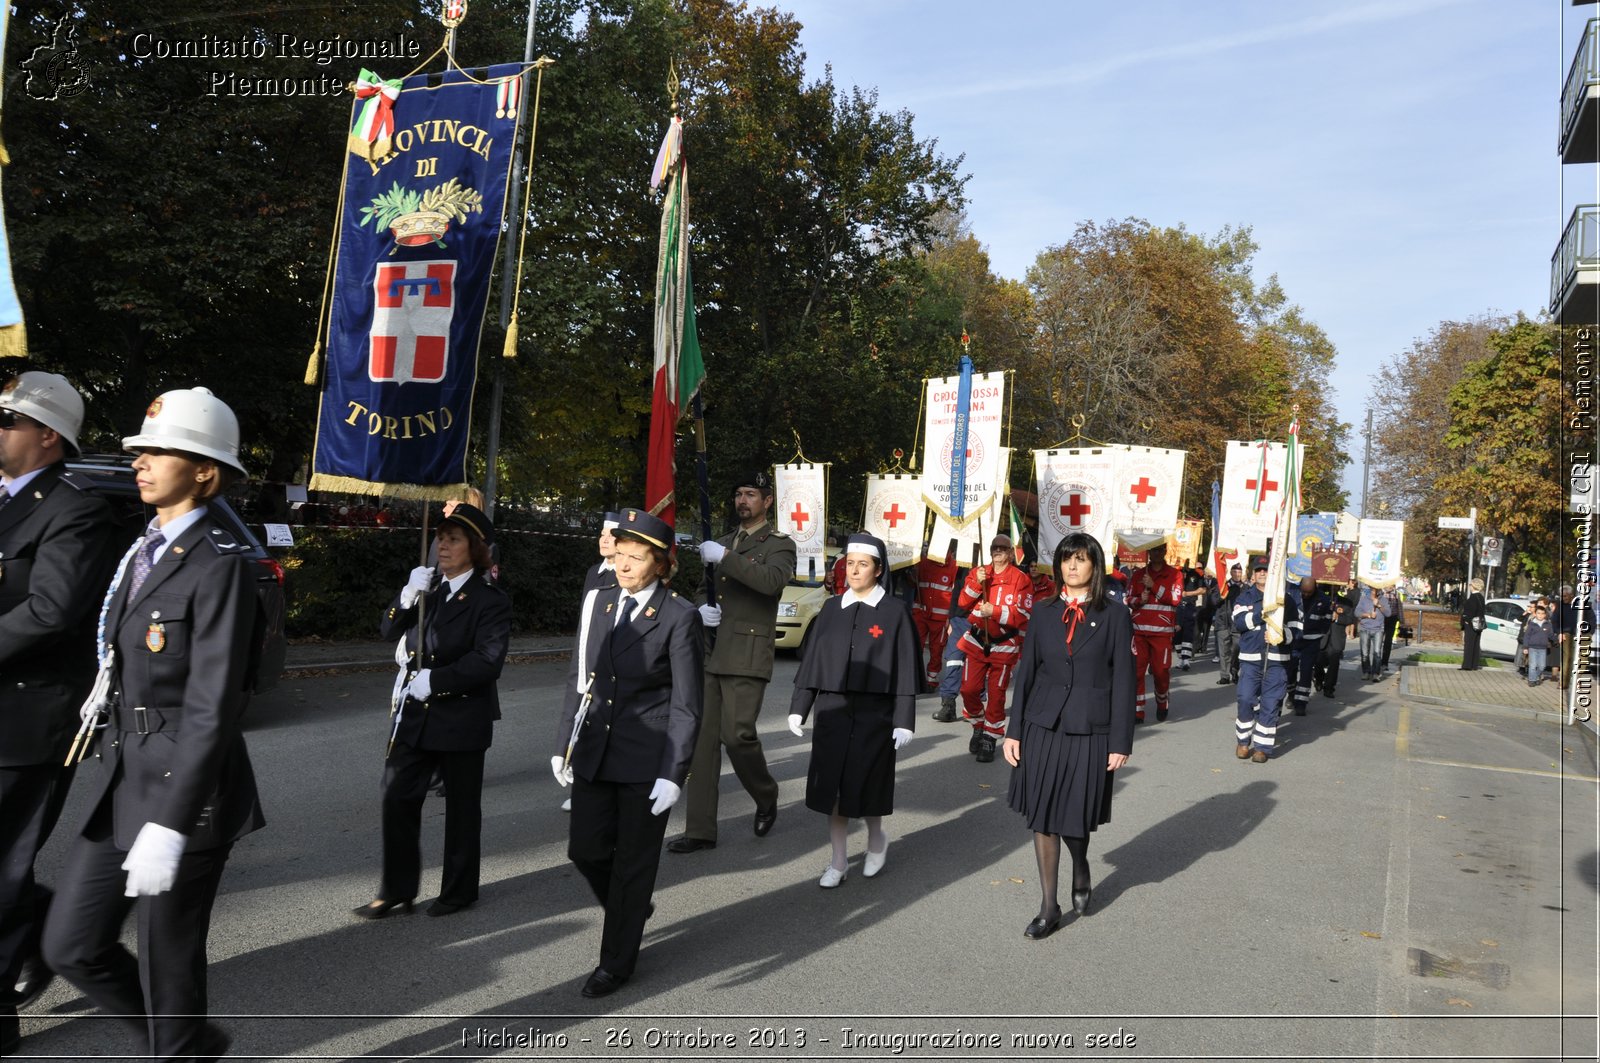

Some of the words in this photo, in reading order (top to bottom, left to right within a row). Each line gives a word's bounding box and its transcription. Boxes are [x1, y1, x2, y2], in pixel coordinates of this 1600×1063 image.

[414, 157, 439, 178] DI
[933, 390, 958, 403] CROC
[972, 386, 999, 399] OSSA
[943, 401, 985, 414] ITANA
[344, 400, 453, 440] TORINO
[955, 413, 965, 450] SOCCORSO
[933, 484, 972, 493] VOLORI
[974, 483, 988, 492] DEL
[951, 470, 960, 511] VOLONTARI
[940, 494, 979, 502] SORSO
